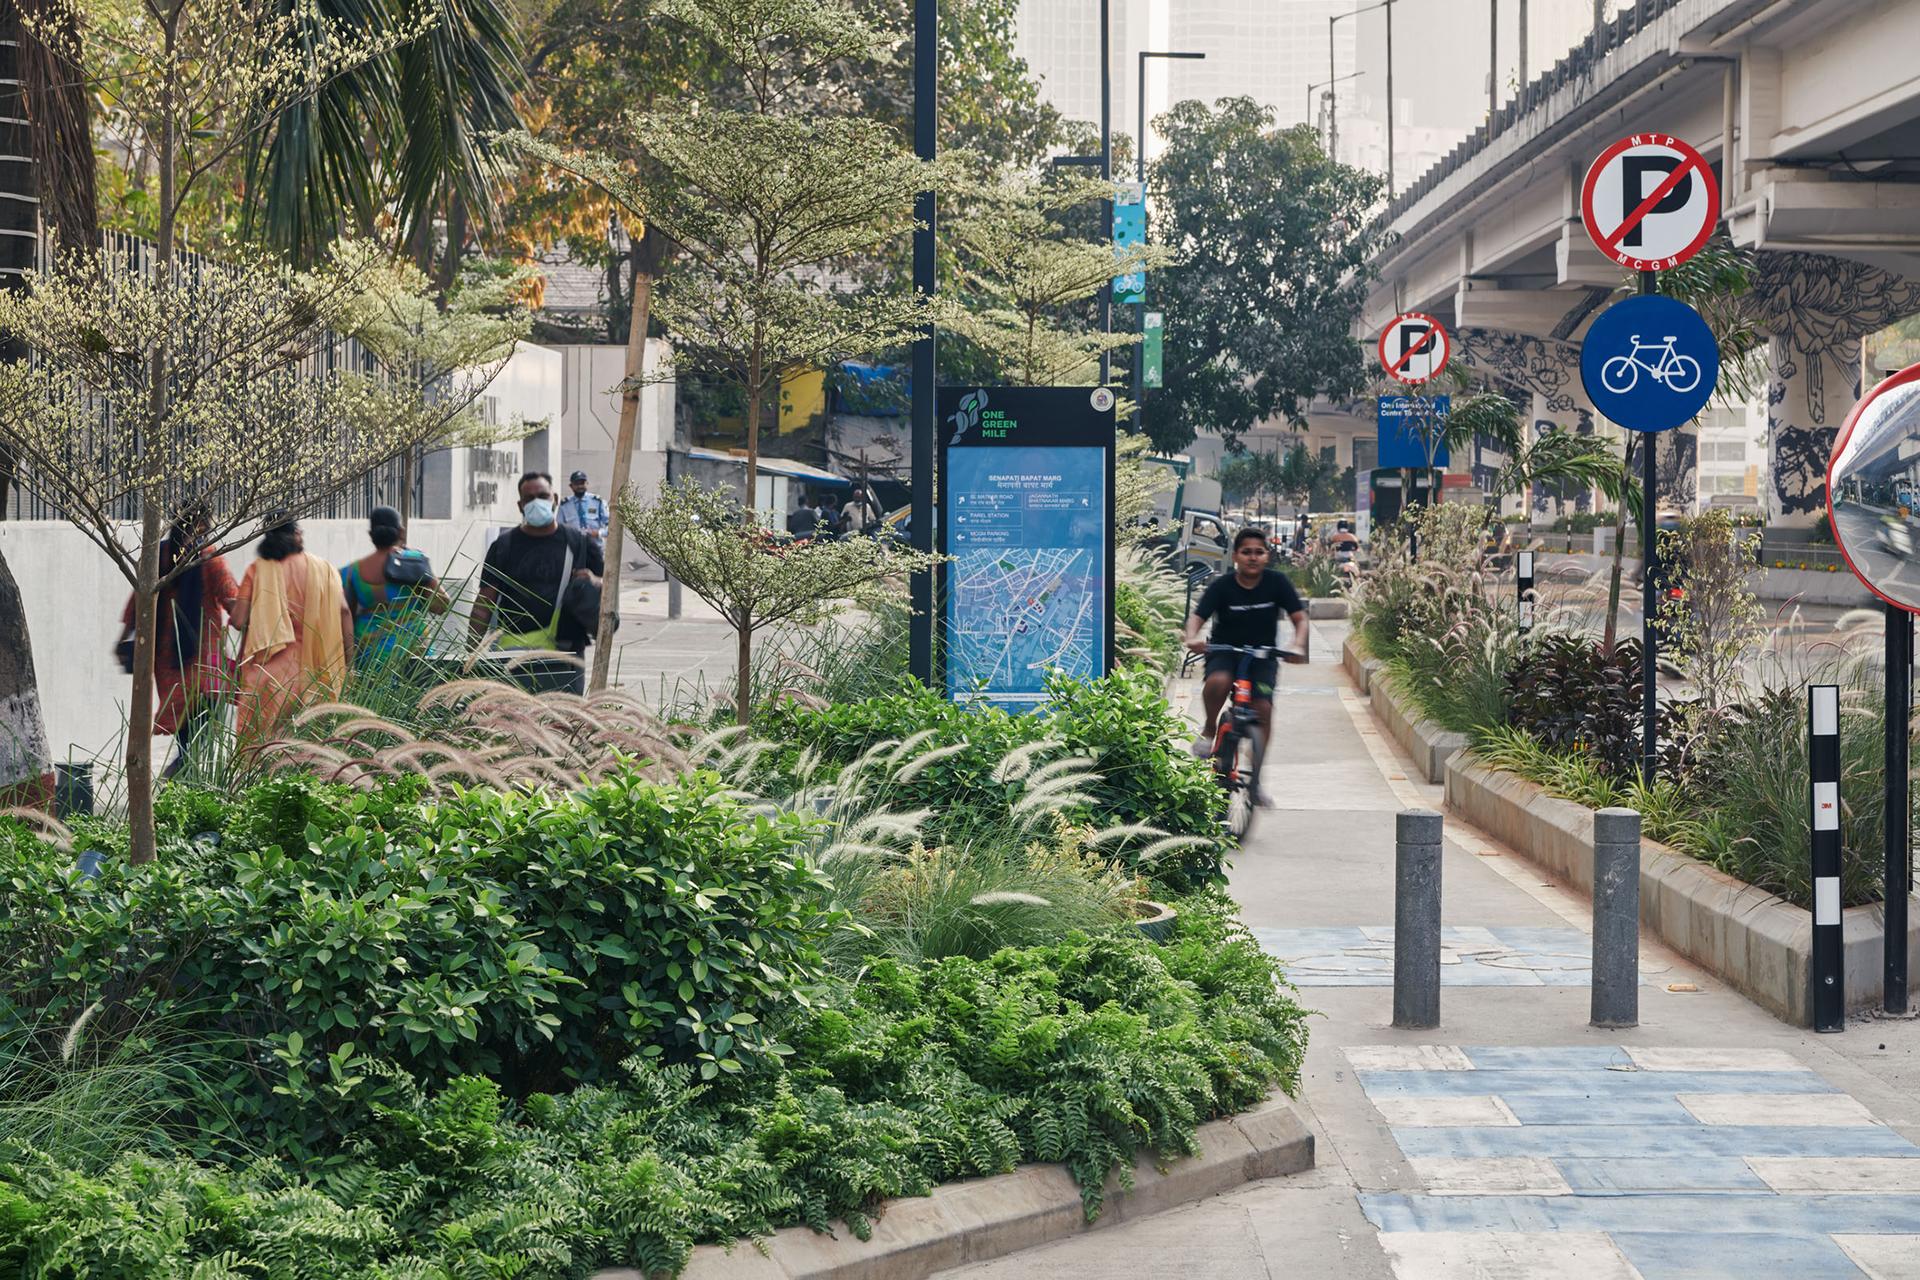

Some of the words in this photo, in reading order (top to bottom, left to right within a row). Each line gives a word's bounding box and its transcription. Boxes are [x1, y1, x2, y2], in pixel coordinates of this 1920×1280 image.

[1631, 135, 1674, 147] MTP
[1622, 156, 1692, 247] P
[1616, 253, 1678, 271] MCGM
[982, 411, 1005, 419] ONE
[982, 420, 1017, 428] GREEN
[982, 430, 1006, 438] MILE
